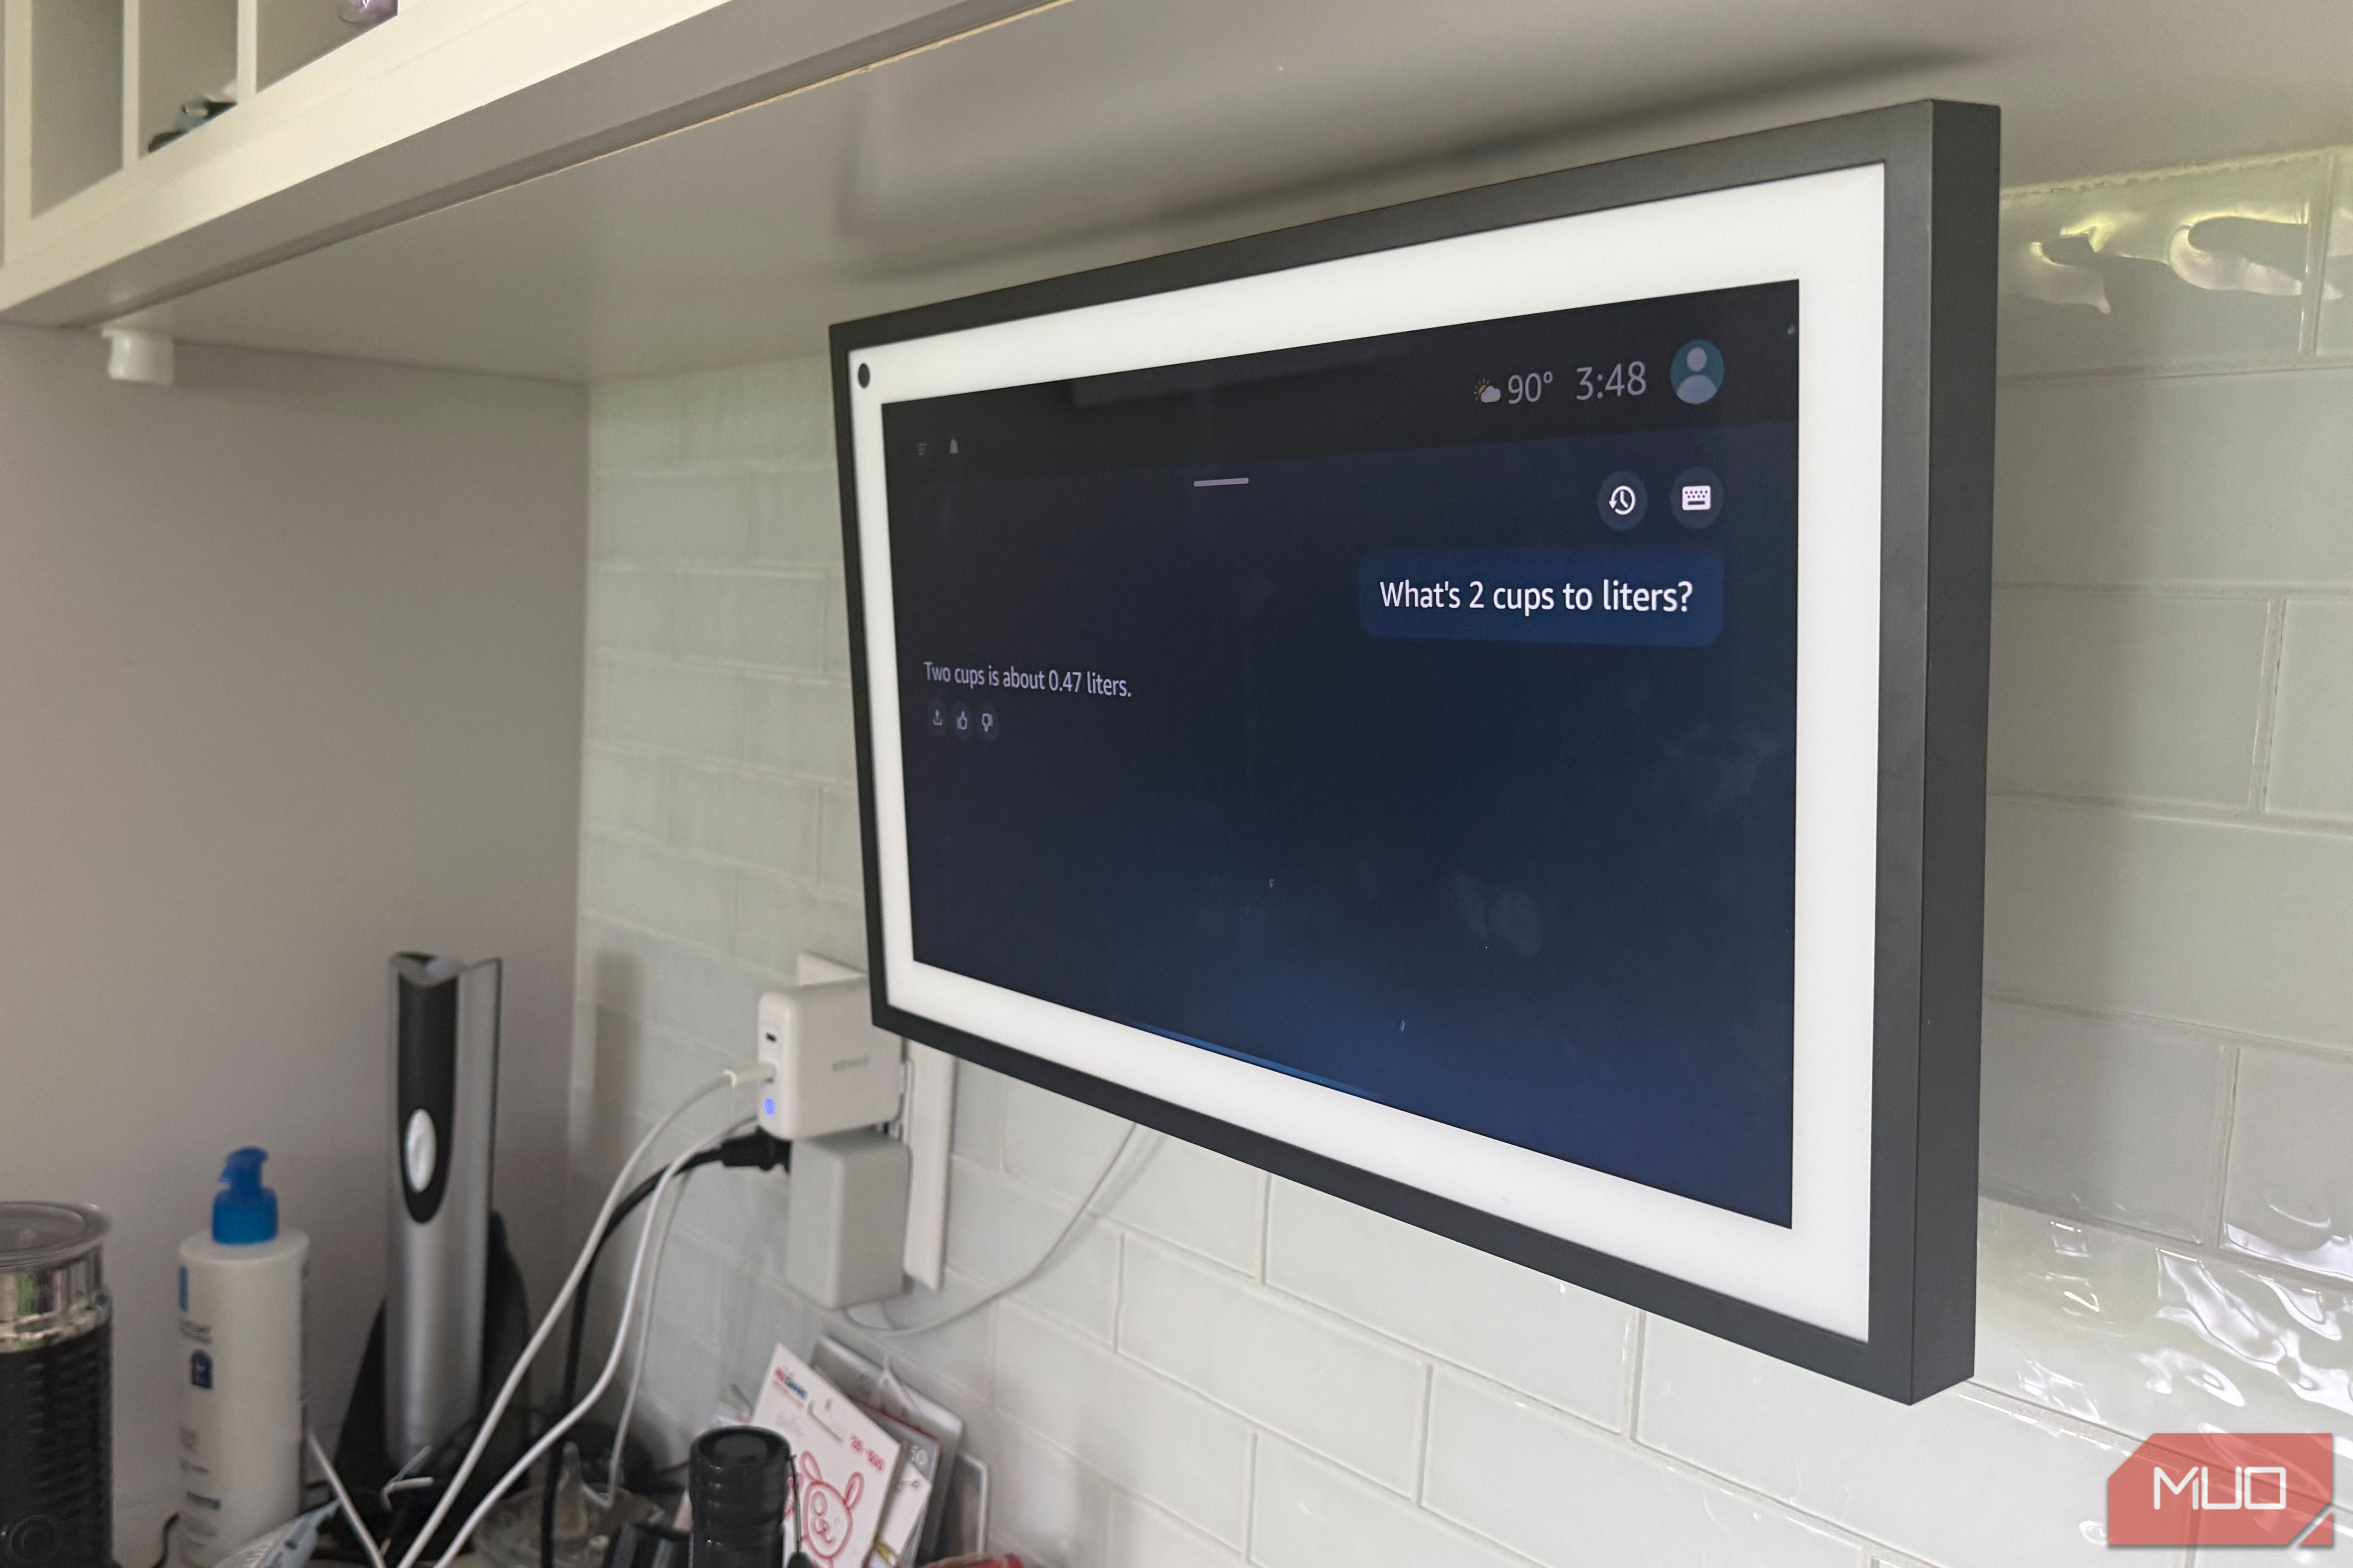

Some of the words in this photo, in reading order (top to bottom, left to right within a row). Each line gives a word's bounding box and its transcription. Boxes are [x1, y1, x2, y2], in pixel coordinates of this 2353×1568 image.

[1508, 371, 1553, 404] 90°
[1576, 360, 1647, 401] 3:48
[1380, 579, 1461, 609] What's
[1469, 580, 1484, 609] 2
[1493, 586, 1555, 617] cups
[1562, 582, 1593, 611] to
[1603, 578, 1694, 613] liters?
[924, 661, 951, 682] Two
[954, 667, 985, 689] cups
[988, 665, 999, 687] is
[1003, 665, 1045, 690] about
[1048, 669, 1082, 693] 0.47
[1086, 670, 1132, 697] liters.
